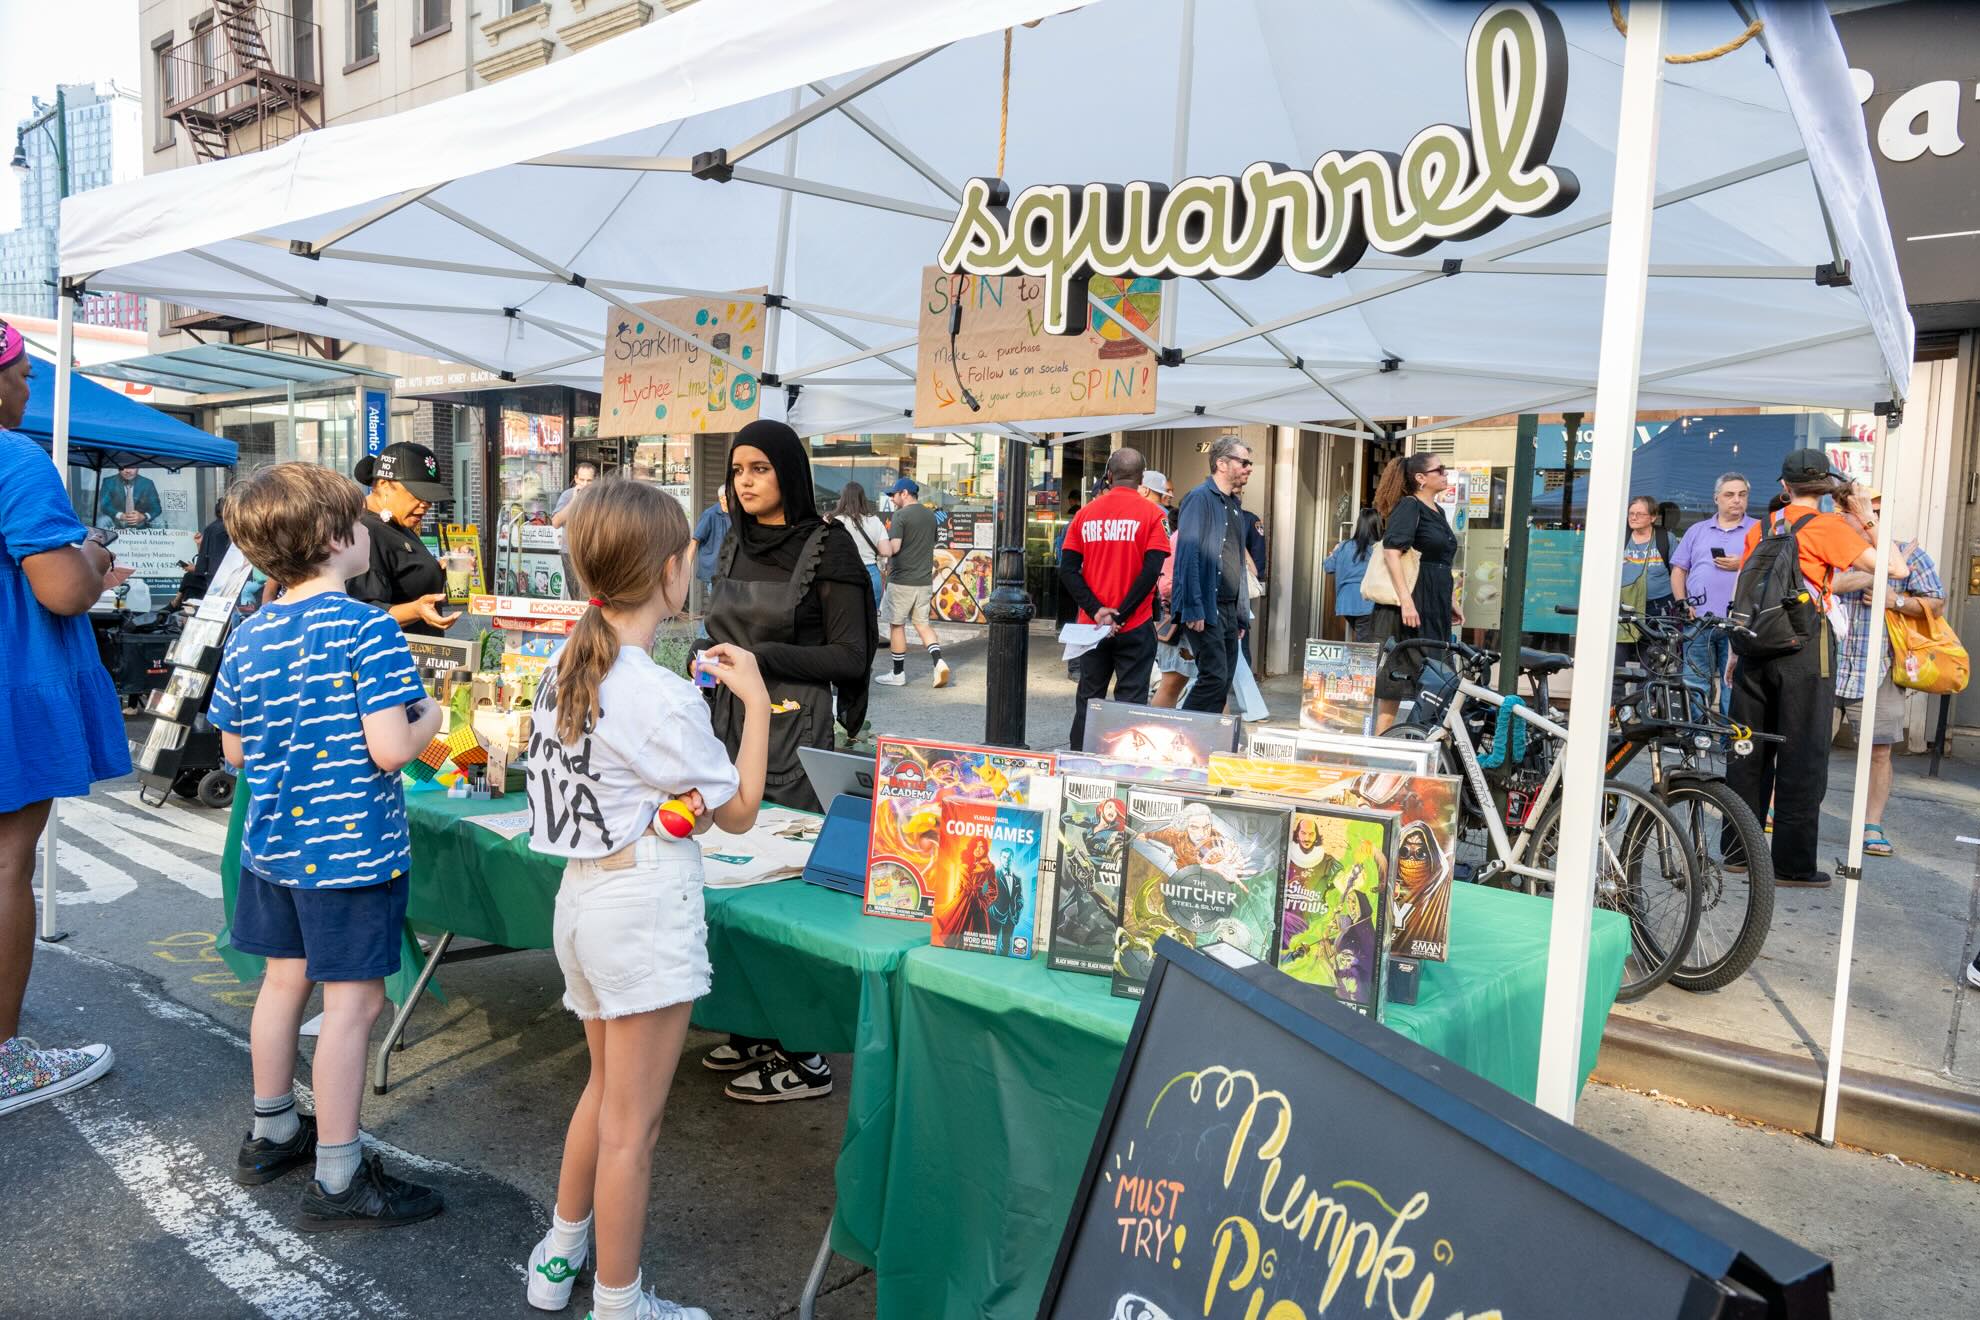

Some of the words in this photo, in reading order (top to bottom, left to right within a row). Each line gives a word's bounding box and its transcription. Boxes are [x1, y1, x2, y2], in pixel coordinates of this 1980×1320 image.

[937, 1, 1580, 336] squarrel
[929, 275, 1004, 315] SPIN
[1017, 276, 1040, 301] to
[614, 327, 700, 366] Sparkling
[934, 347, 970, 363] Make
[996, 342, 1041, 361] purchase
[968, 366, 1004, 384] Follow
[1009, 367, 1019, 376] us
[1039, 360, 1069, 374] socials
[368, 407, 381, 451] Atlantic
[381, 454, 397, 464] POST
[376, 469, 394, 478] BILLS
[1081, 519, 1103, 543] FIRE
[1104, 519, 1141, 541] SAFETY
[532, 603, 588, 615] MONOPOLY
[410, 643, 436, 655] ELCOME
[1309, 646, 1342, 660] EXIT
[1253, 741, 1293, 757] UNMATCHED
[880, 784, 934, 800] ACADEMY
[1068, 782, 1113, 800] UNMATCHED
[1132, 798, 1179, 817] UNMATCHED
[946, 819, 1035, 845] CODENAMES
[1192, 879, 1207, 887] THE
[1287, 880, 1321, 901] Slings
[1160, 882, 1239, 908] WITCHER
[1171, 900, 1193, 908] STEEL
[1285, 898, 1328, 915] rrows
[963, 936, 980, 944] WORD
[981, 938, 997, 947] GAME
[1114, 1175, 1185, 1219] MUST
[1147, 1065, 1503, 1320] Pumpki
[1118, 1218, 1187, 1270] TRY!
